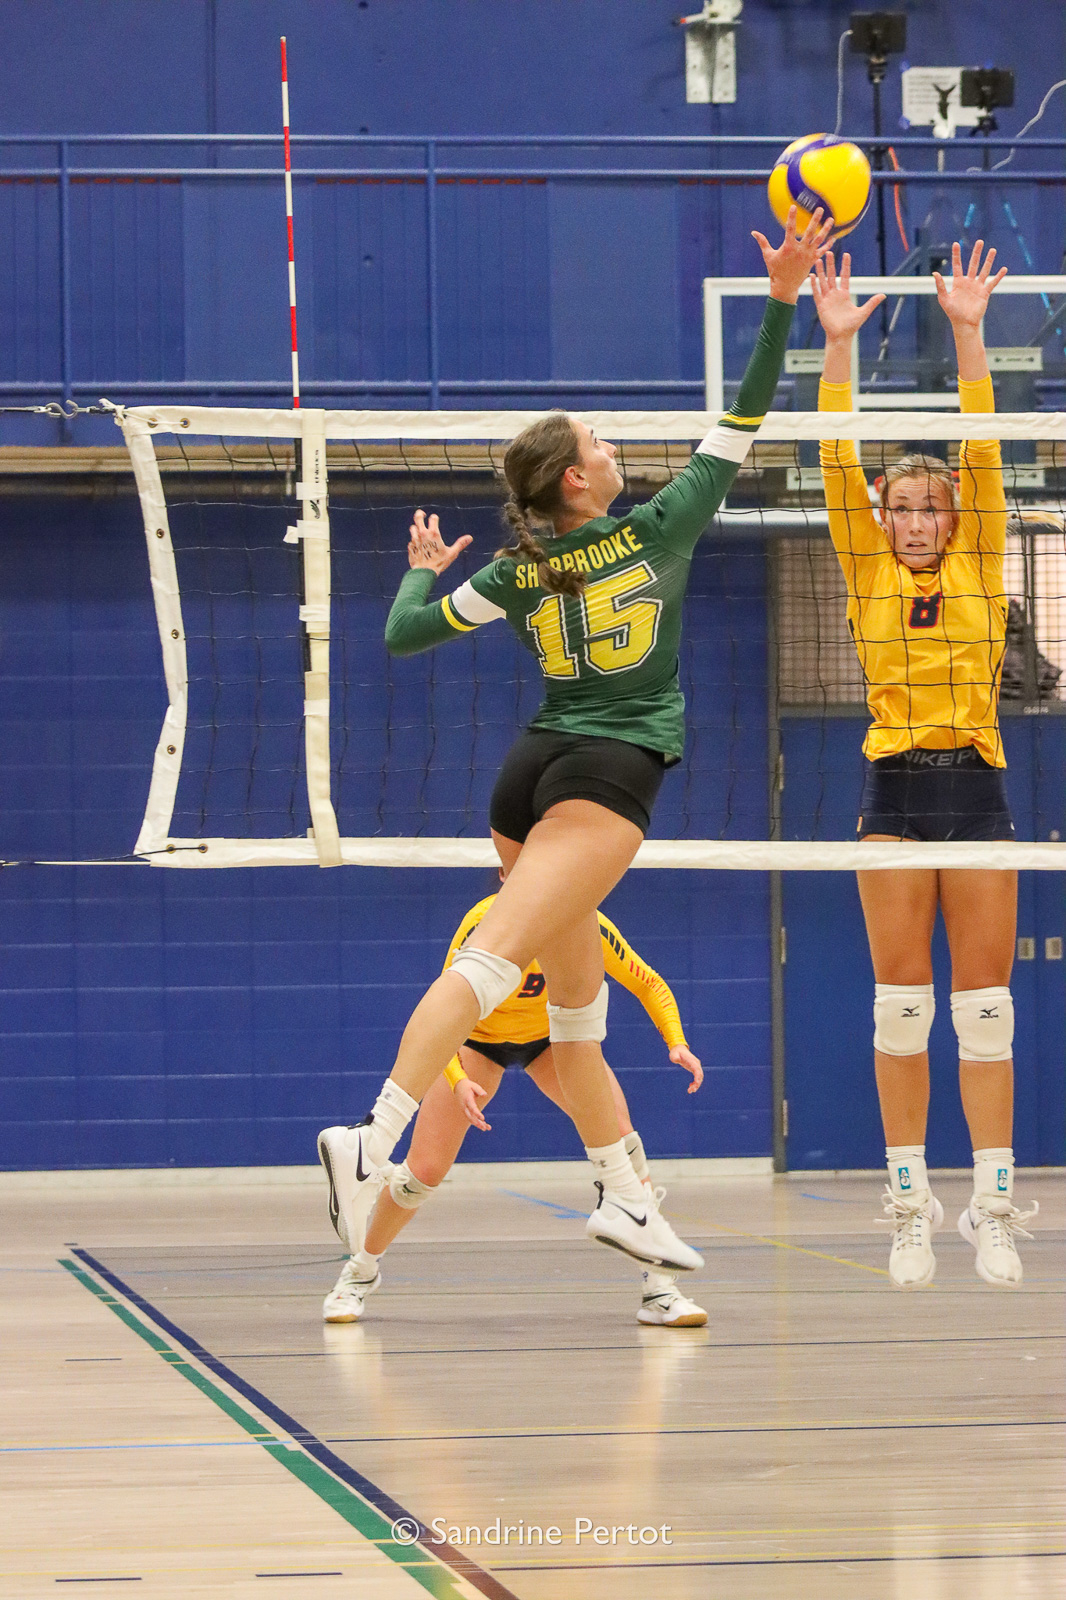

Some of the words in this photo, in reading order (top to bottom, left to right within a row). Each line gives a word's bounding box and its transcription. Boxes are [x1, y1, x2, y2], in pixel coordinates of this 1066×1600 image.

[515, 526, 643, 589] SHRBROOKE
[526, 560, 663, 679] 15
[909, 591, 942, 629] 8
[517, 973, 546, 998] 9
